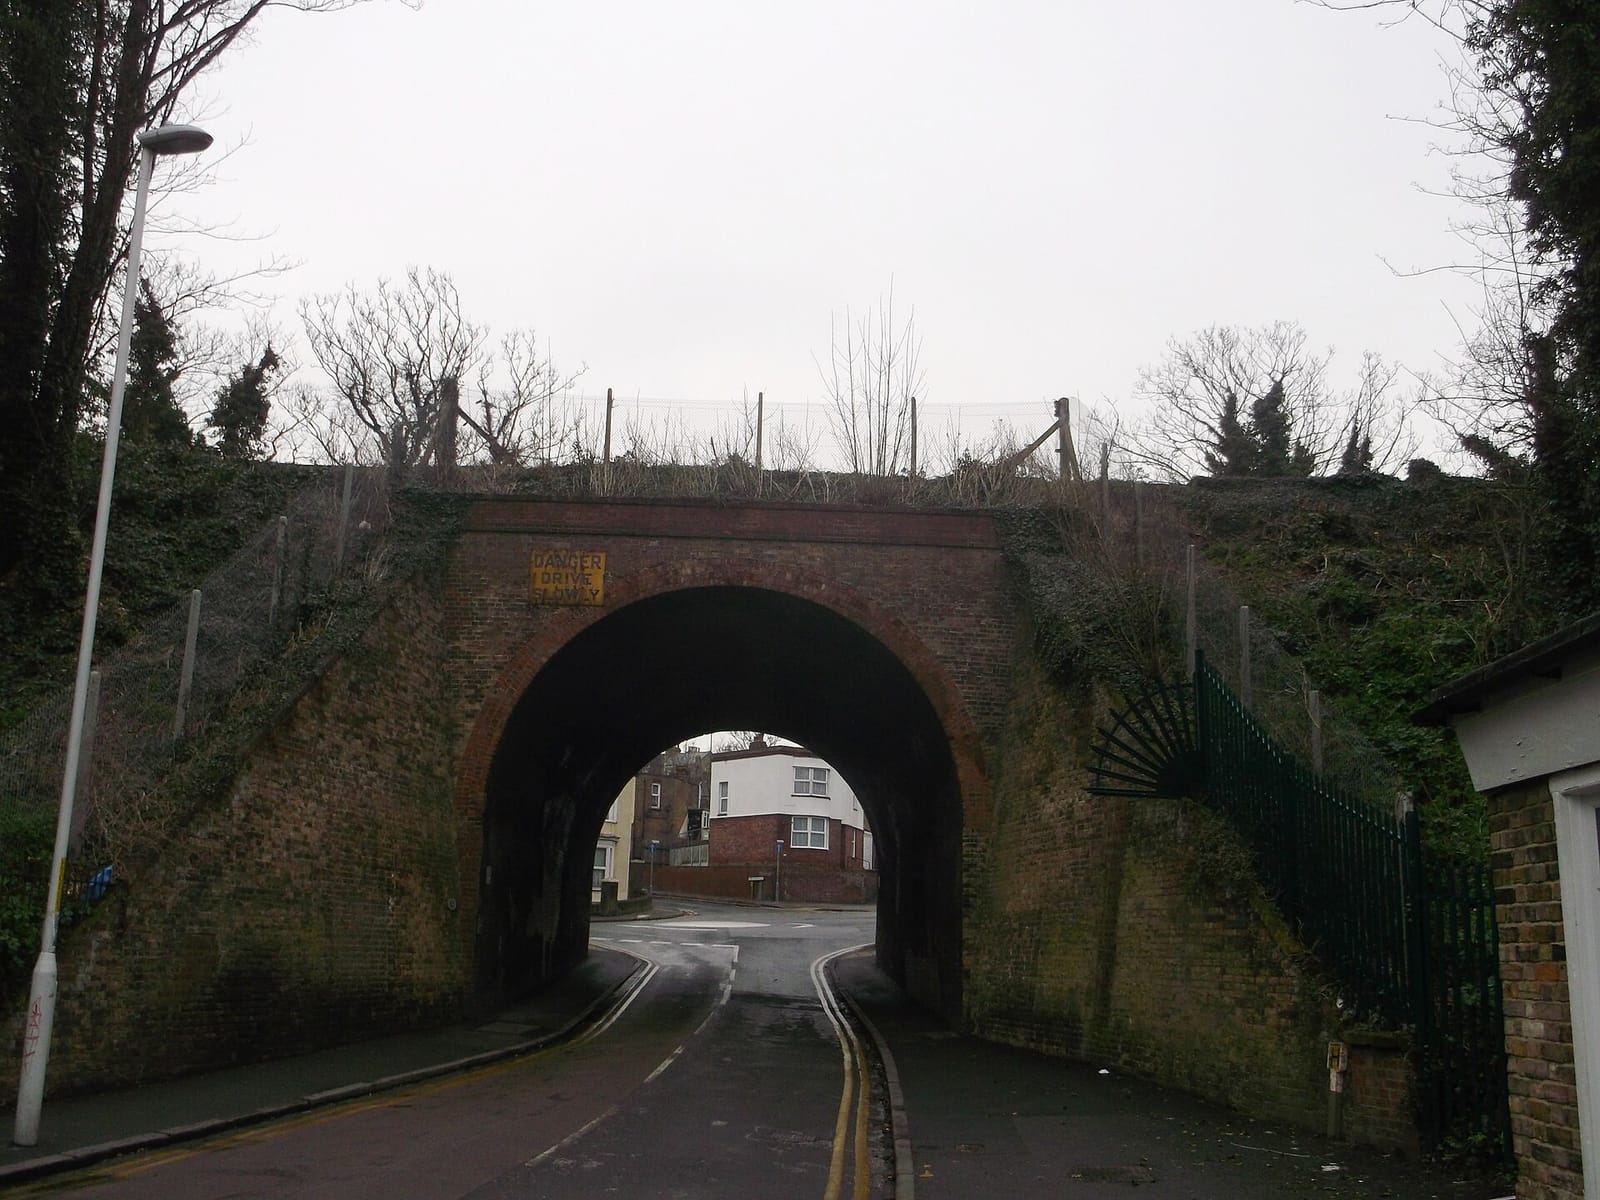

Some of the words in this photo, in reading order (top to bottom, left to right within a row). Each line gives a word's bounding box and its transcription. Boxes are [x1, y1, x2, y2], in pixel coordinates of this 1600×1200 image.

[534, 553, 602, 570] DANGER
[541, 571, 593, 586] DRIVE
[531, 587, 600, 602] SLOWLY
